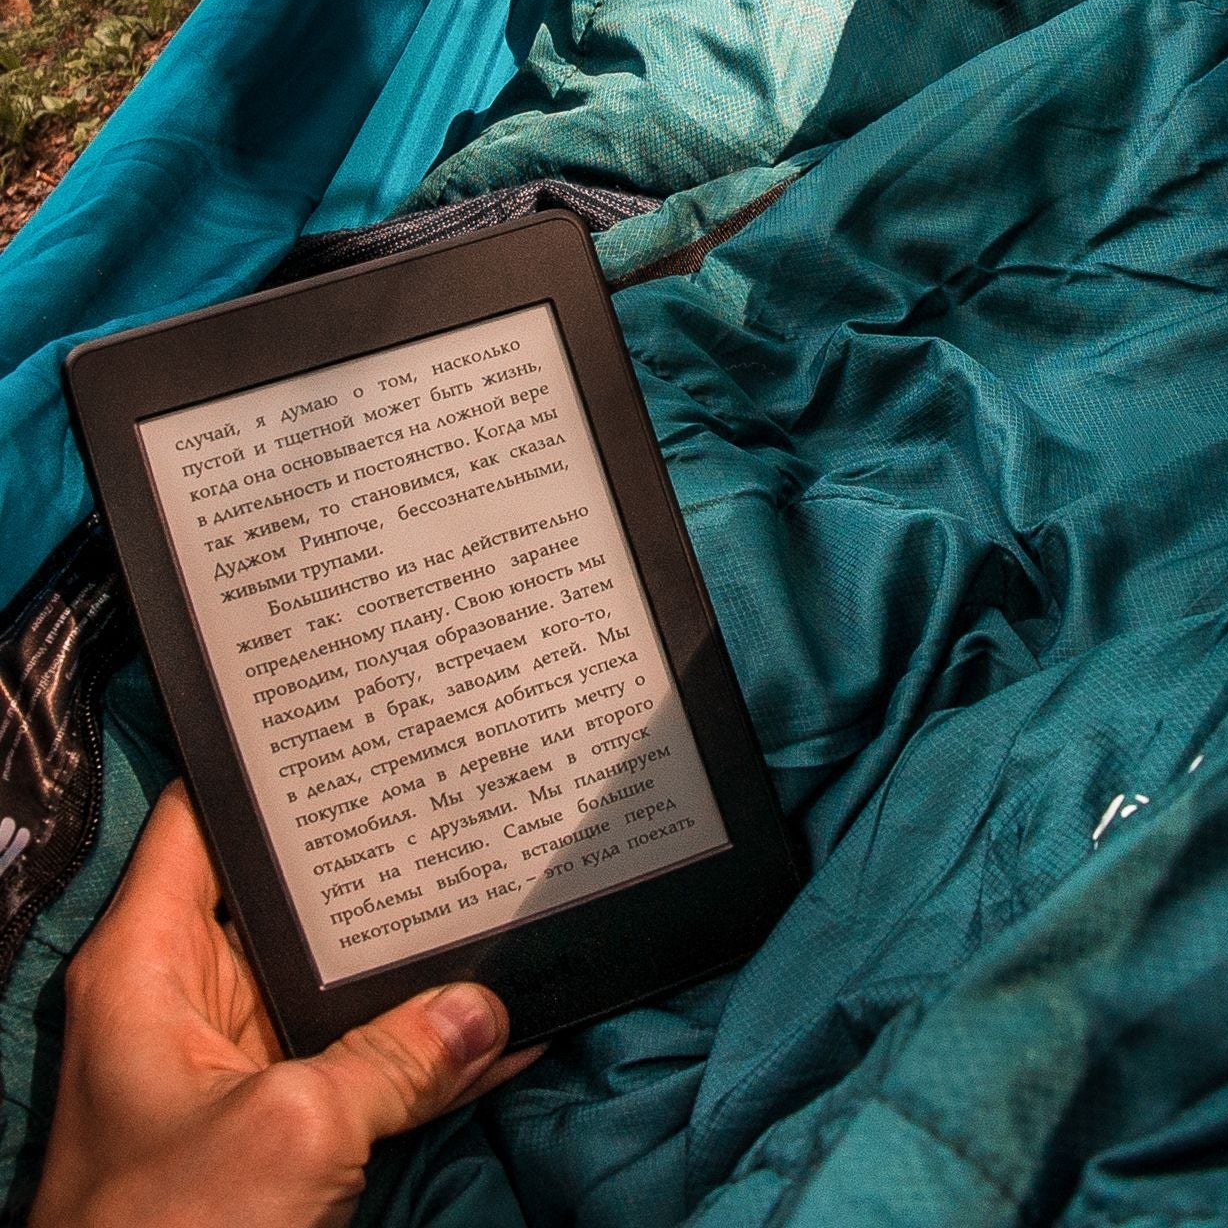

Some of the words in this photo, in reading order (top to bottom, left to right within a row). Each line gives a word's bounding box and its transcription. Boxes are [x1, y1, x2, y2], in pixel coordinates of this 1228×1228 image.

[174, 422, 241, 452] случай,
[255, 415, 267, 429] я
[280, 395, 339, 423] думаю
[352, 387, 364, 399] о
[377, 372, 418, 391] том,
[431, 340, 521, 376] насколько
[181, 447, 246, 479] пустой
[253, 442, 267, 456] и
[273, 414, 355, 450] тщетной
[362, 396, 421, 423] может
[429, 382, 474, 402] быть
[481, 362, 542, 387] жизнь,
[189, 479, 240, 503] когда
[243, 468, 277, 486] она
[281, 428, 405, 475] основывается
[408, 421, 432, 437] на
[436, 395, 506, 429] ложной
[509, 384, 550, 406] вере
[196, 515, 208, 528] в
[213, 478, 333, 526] длительность
[335, 472, 350, 486] и
[352, 437, 470, 481] постоянство.
[472, 419, 526, 444] Когда
[529, 408, 559, 426] мы
[203, 534, 236, 553] так
[243, 513, 310, 542] живем,
[318, 503, 341, 518] то
[350, 467, 460, 509] становимся,
[468, 453, 500, 472] как
[509, 433, 567, 459] сказал
[213, 546, 287, 582] Дуджом
[298, 518, 384, 552] Ринпоче,
[397, 459, 569, 521] бессознательными,
[219, 570, 298, 604] живыми
[299, 545, 384, 581] трупами.
[236, 626, 292, 654] живет
[305, 612, 343, 633] так:
[356, 563, 496, 616] соответственно
[510, 536, 580, 568] заранее
[244, 625, 386, 679] определенному
[389, 606, 450, 634] плану.
[454, 588, 504, 612] Свою
[508, 565, 574, 595] юность
[577, 553, 607, 573] мы
[266, 570, 390, 617] Большинство
[395, 561, 418, 577] из
[422, 549, 455, 569] нас
[461, 506, 589, 559] действительно
[252, 666, 349, 706] проводим,
[354, 639, 430, 673] получая
[435, 600, 555, 646] образование.
[559, 578, 614, 605] Затем
[261, 694, 341, 729] находим
[353, 670, 422, 705] работу,
[435, 634, 528, 674] встречаем
[540, 608, 611, 639] кого-то,
[269, 718, 355, 755] вступаем
[364, 711, 376, 724] в
[386, 693, 435, 718] брак,
[446, 663, 521, 698] заводим
[532, 640, 587, 672] детей.
[596, 626, 631, 646] Мы
[278, 748, 346, 778] строим
[351, 735, 391, 759] дом,
[397, 701, 489, 740] стараемся
[494, 672, 574, 712] добиться
[577, 651, 639, 685] успеха
[286, 791, 298, 804] в
[306, 772, 362, 800] делах,
[370, 735, 468, 777] стремимся
[474, 703, 567, 743] воплотить
[573, 681, 625, 709] мечту
[634, 675, 646, 687] о
[294, 795, 370, 829] покупке
[381, 777, 427, 803] дома
[435, 770, 448, 783] в
[459, 742, 530, 778] деревне
[540, 726, 575, 747] или
[585, 699, 654, 732] второго
[304, 808, 417, 852] автомобиля.
[428, 791, 464, 812] Мы
[475, 760, 554, 801] уезжаем
[566, 752, 578, 765] в
[590, 726, 651, 756] отпуск
[312, 842, 396, 876] отдыхать
[406, 834, 417, 846] с
[430, 801, 518, 841] друзьями.
[527, 784, 563, 805] Мы
[573, 745, 672, 790] планируем
[320, 877, 366, 906] уйти
[378, 866, 402, 883] на
[414, 839, 490, 871] пенсию.
[503, 811, 564, 839] Самые
[576, 778, 655, 814] большие
[329, 885, 424, 926] проблемы
[435, 859, 508, 891] выбора,
[520, 821, 611, 861] встающие
[623, 797, 677, 826] перед
[338, 902, 452, 949] некоторыми
[457, 894, 480, 910] из
[485, 880, 522, 901] нас,
[543, 860, 575, 880] это
[580, 844, 621, 868] куда
[626, 816, 696, 850] поехать
